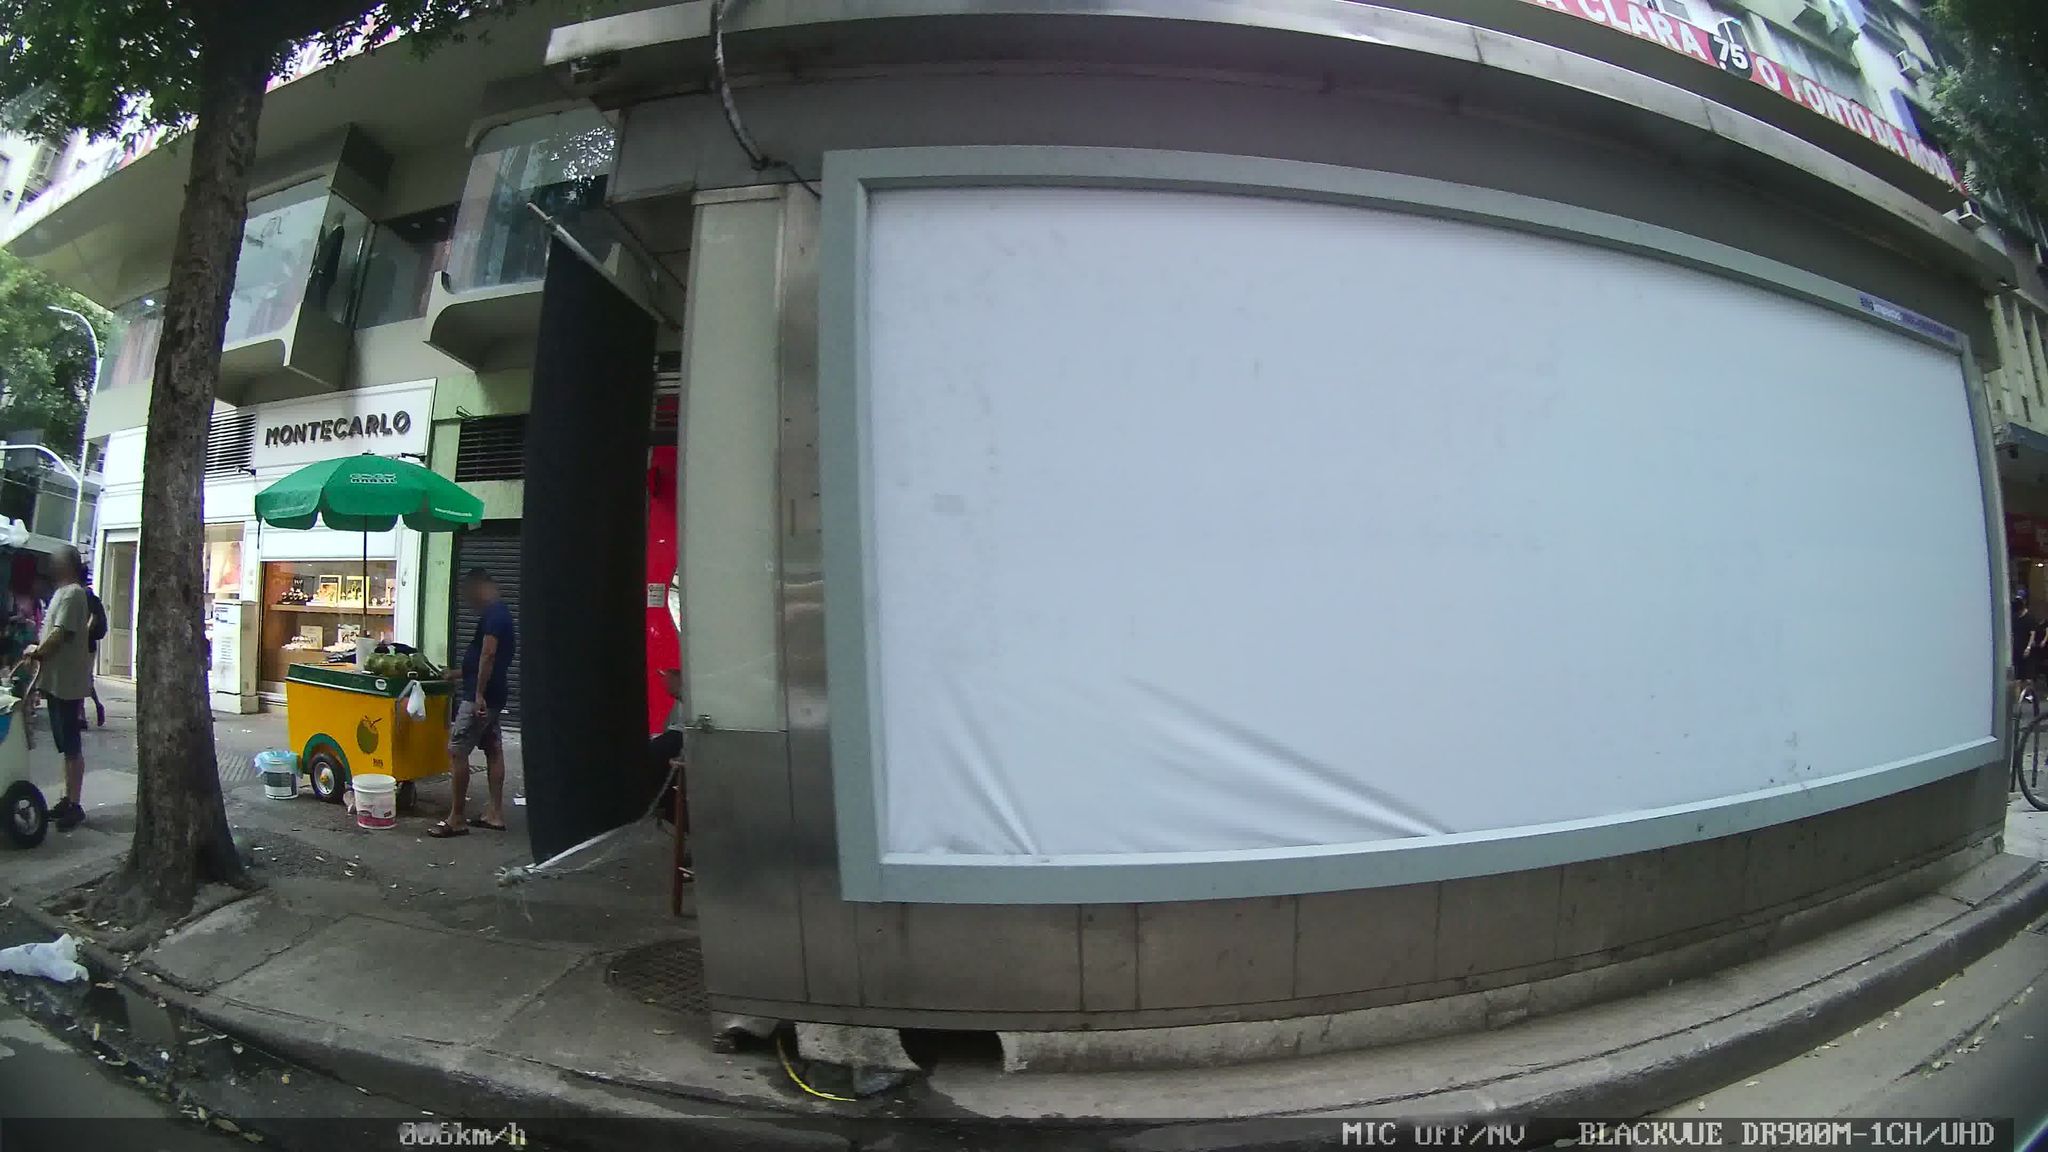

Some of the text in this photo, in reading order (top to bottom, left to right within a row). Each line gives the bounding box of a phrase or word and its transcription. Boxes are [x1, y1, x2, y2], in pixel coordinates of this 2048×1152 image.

[1577, 0, 1708, 61] CLARA
[1755, 56, 1781, 91] O
[264, 410, 411, 447] MONTECARLO
